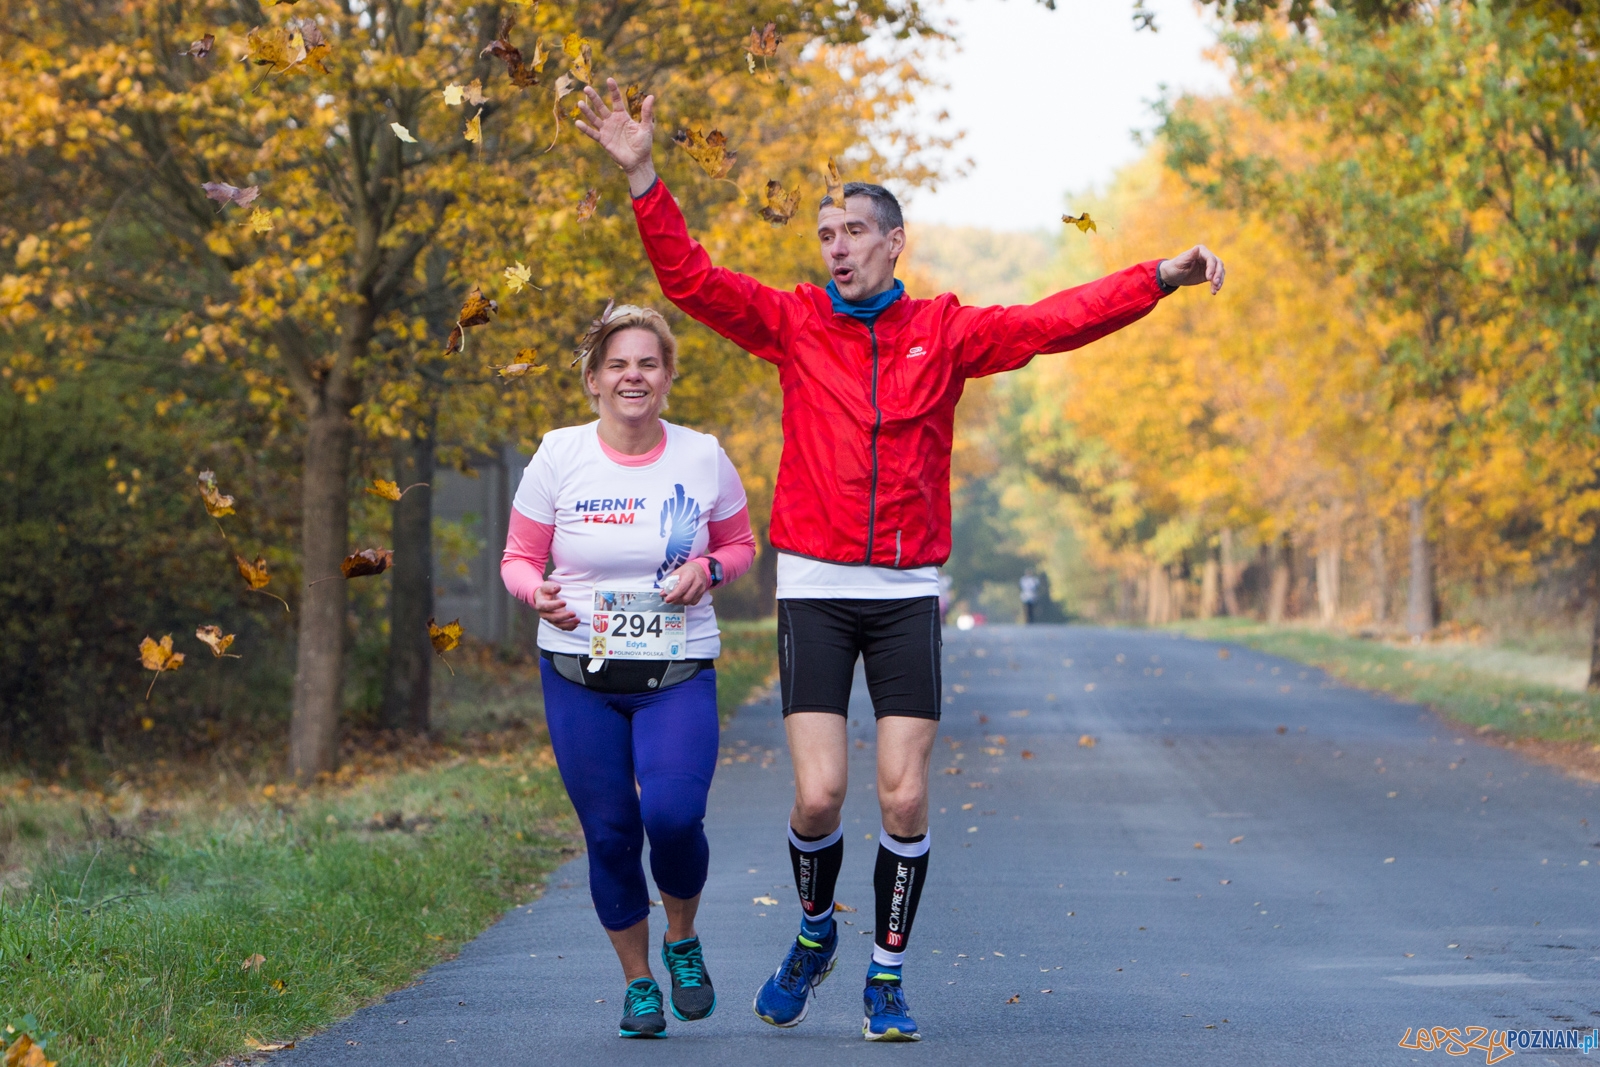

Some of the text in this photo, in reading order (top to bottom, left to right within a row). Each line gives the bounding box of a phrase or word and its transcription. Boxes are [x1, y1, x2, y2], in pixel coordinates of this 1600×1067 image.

[575, 498, 647, 512] HERNIK
[582, 512, 635, 524] TEAM
[611, 613, 663, 638] 294
[626, 640, 647, 648] Edyta
